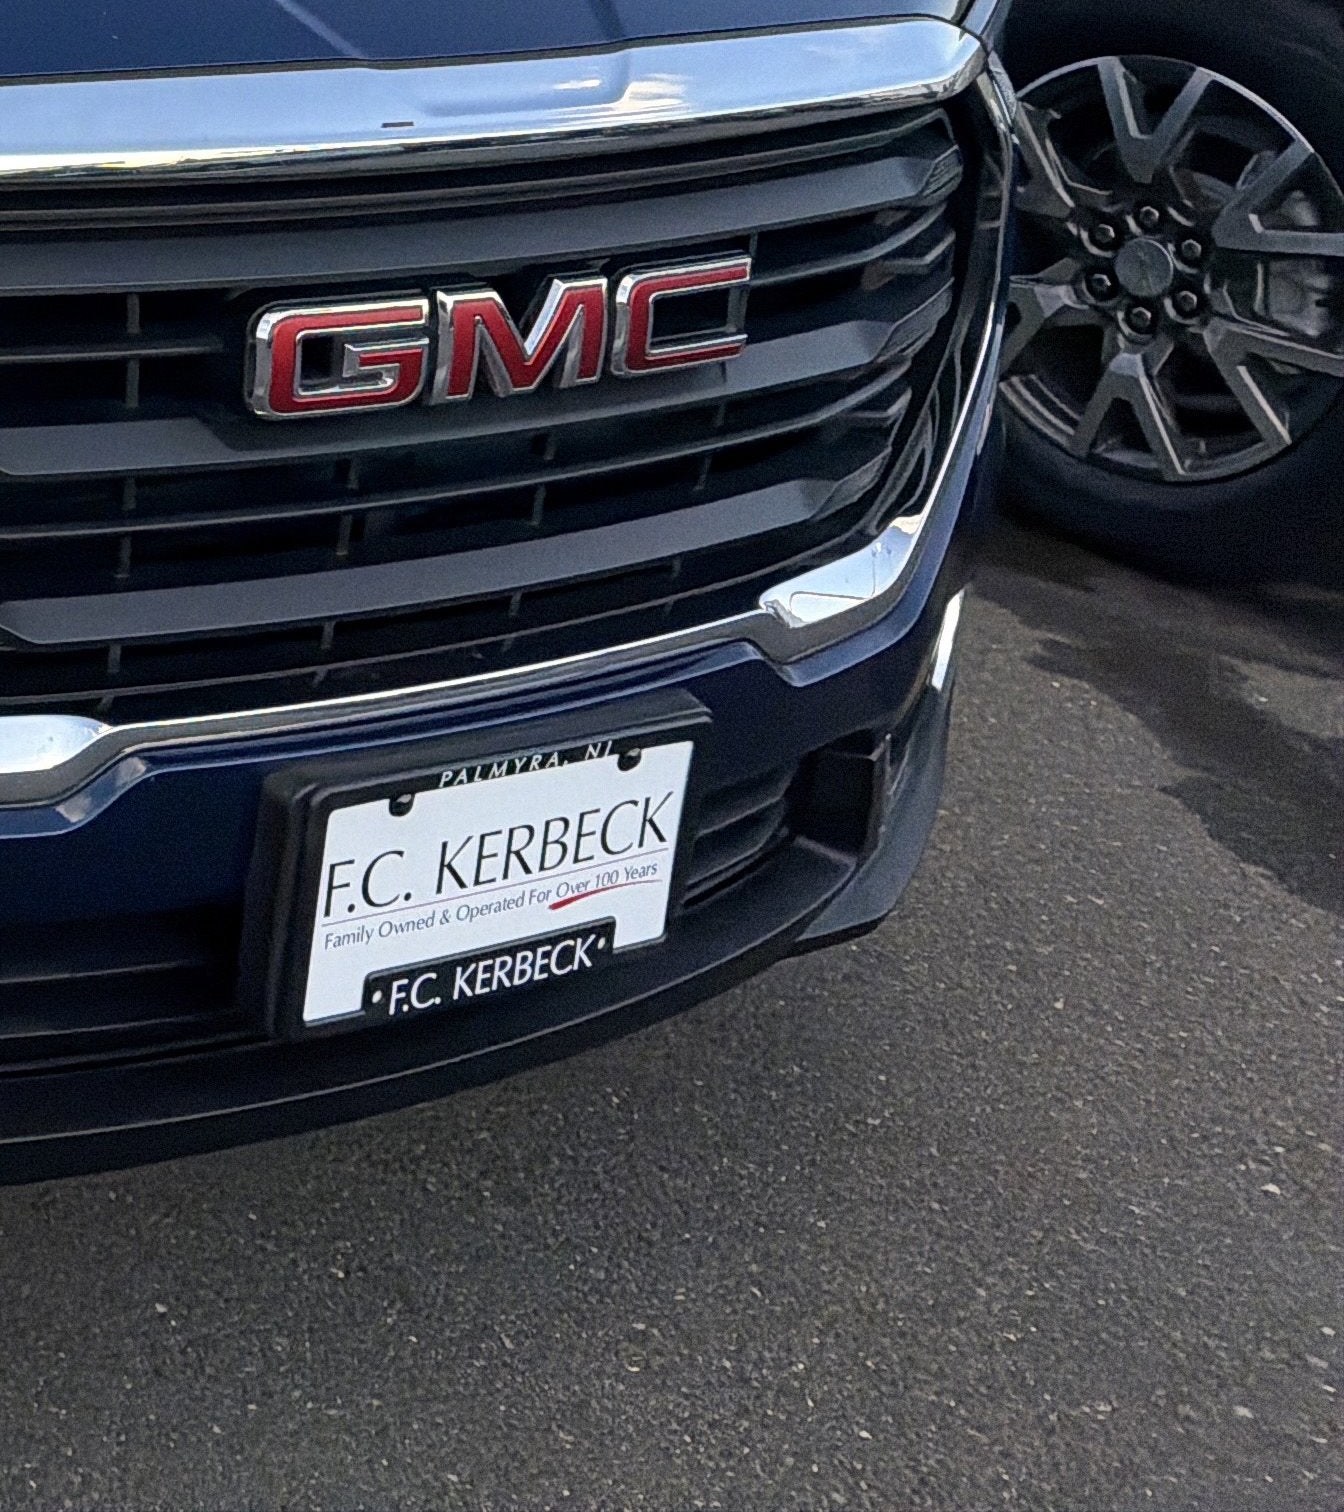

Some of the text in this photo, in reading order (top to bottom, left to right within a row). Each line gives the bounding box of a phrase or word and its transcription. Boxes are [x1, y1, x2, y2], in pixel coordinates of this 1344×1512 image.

[247, 254, 752, 420] GMC
[324, 791, 674, 918] F.C. KERBECK
[324, 862, 658, 951] Family Owned & Operated For Over 100 Years
[388, 934, 596, 1015] F.C. KERBECK
